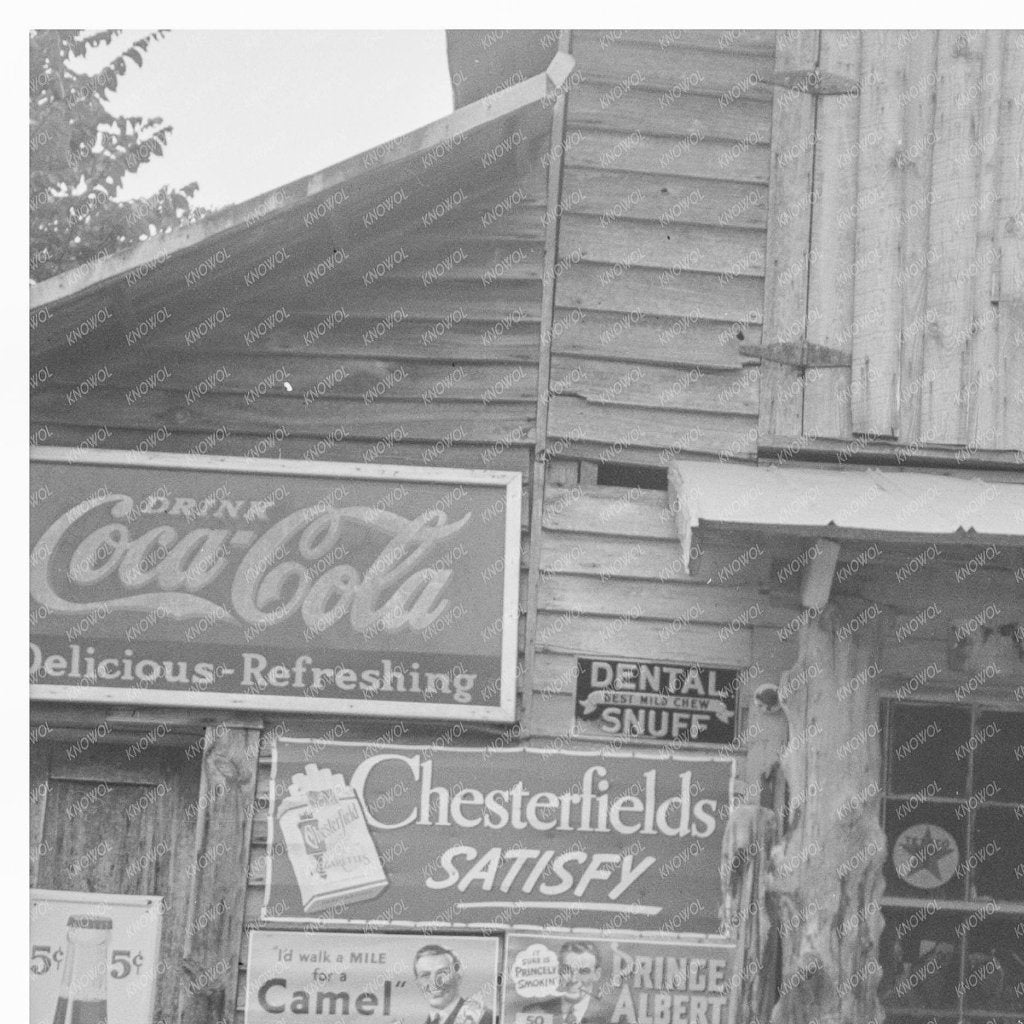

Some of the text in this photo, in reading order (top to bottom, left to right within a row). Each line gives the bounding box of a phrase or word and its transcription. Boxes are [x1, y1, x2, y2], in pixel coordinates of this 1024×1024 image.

[144, 496, 271, 521] DRINK
[29, 494, 473, 633] Coca-Cola
[590, 661, 733, 698] DENTAL
[601, 707, 711, 739] SNUFF
[350, 753, 717, 838] Chesterfields
[426, 846, 657, 900] SATISFY
[110, 950, 144, 979] 5¢
[299, 949, 331, 963] walk
[336, 953, 344, 963] a
[349, 952, 387, 965] MILE
[613, 954, 728, 994] PRINCE
[313, 968, 347, 982] for a
